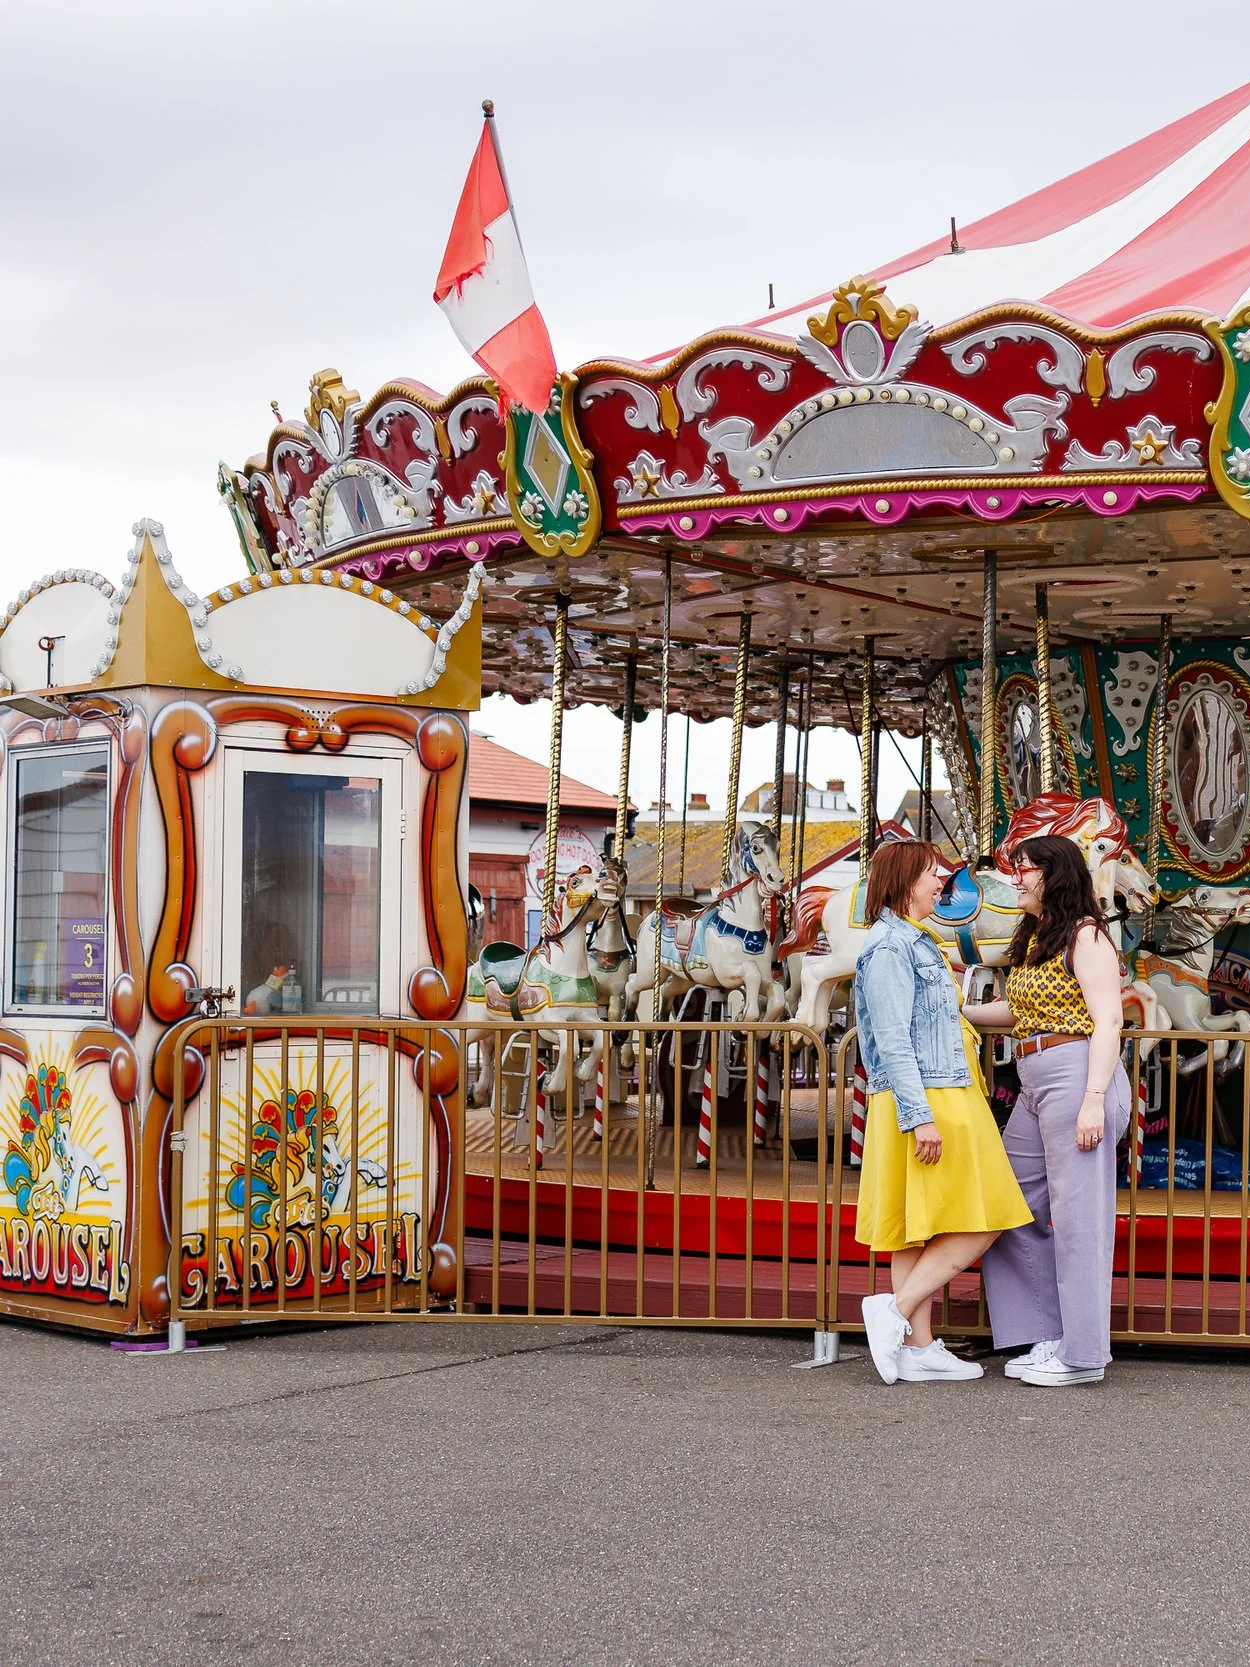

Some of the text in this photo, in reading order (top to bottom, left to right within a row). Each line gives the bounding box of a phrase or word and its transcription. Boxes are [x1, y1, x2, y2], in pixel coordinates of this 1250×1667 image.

[72, 924, 104, 934] CAROUSEL
[84, 943, 93, 968] 3
[0, 1218, 129, 1302] AROUSEL
[167, 1212, 431, 1307] CAROUSEL
